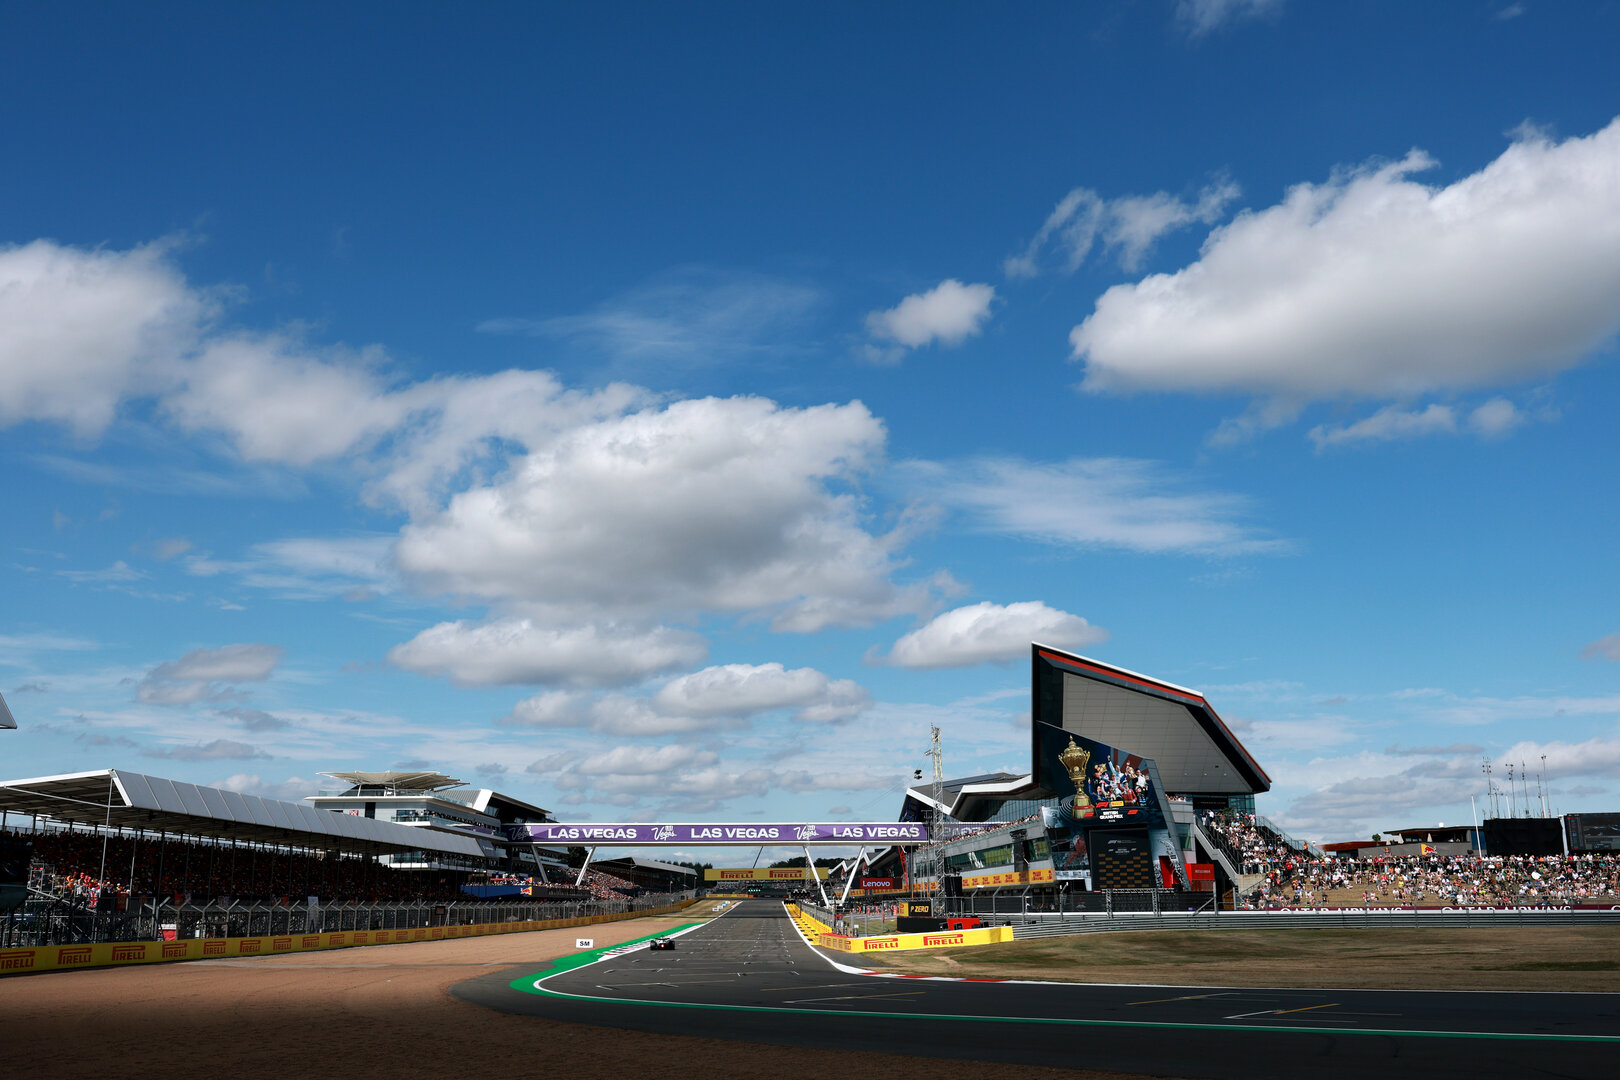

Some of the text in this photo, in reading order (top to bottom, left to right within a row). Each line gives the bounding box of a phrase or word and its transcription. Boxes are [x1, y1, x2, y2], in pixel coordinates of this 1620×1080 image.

[548, 828, 637, 839] LAS VEGAS
[691, 828, 779, 838] LAS VEGAS
[832, 827, 920, 838] LAS VEGAS
[240, 940, 261, 952] PIRELLI
[273, 938, 292, 950] PIRELLI
[864, 938, 898, 949] PIRELLI
[923, 934, 963, 946] PIRELLI
[112, 945, 146, 961] PIRELLI
[162, 943, 187, 958] PIRELLI
[204, 941, 226, 955] PIRELLI
[58, 948, 92, 965] PIRELLI
